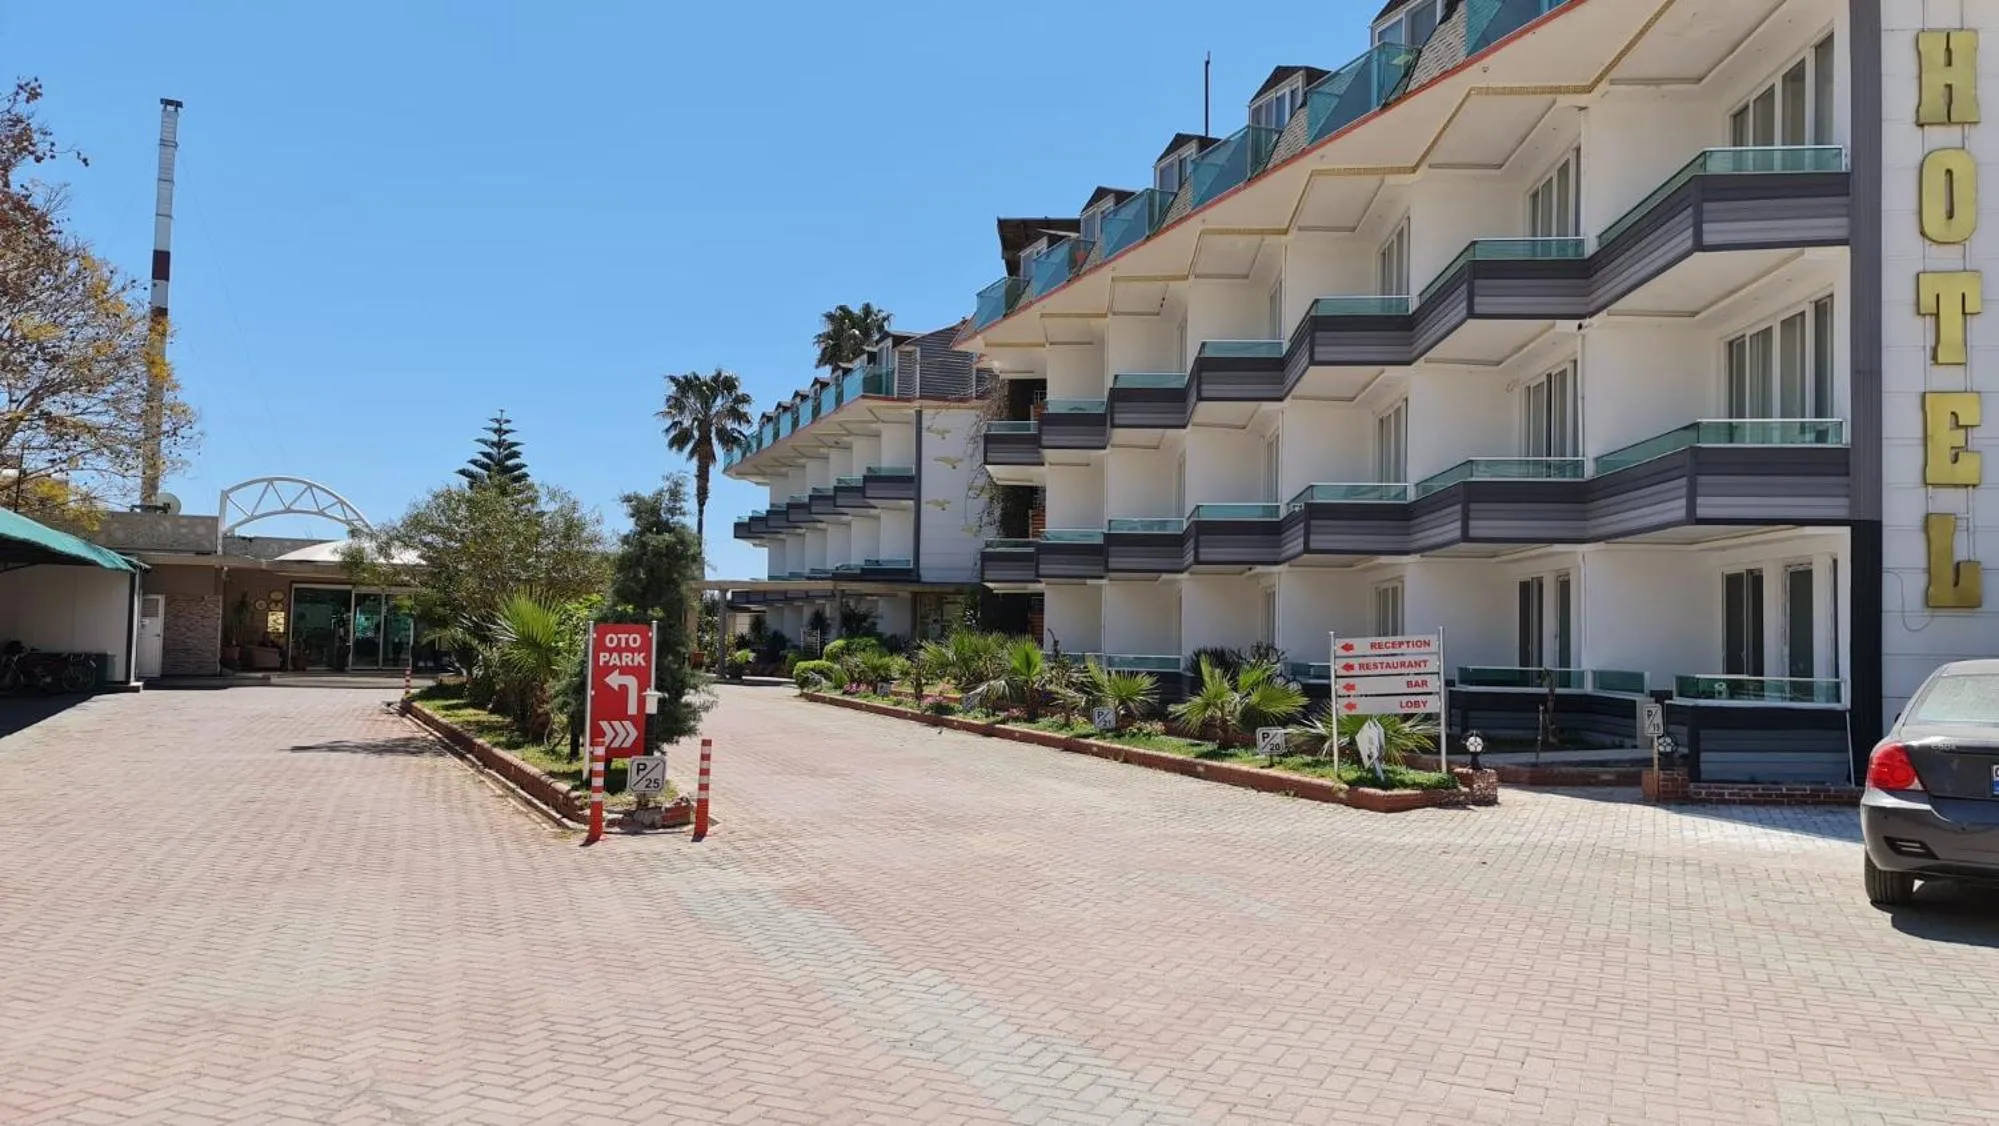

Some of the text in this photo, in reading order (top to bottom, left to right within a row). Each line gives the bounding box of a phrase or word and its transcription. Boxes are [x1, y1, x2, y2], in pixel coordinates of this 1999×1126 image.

[1916, 29, 1982, 608] HOTEL
[605, 633, 641, 648] OTO
[1370, 639, 1431, 651] RECEPTION
[599, 652, 646, 666] PARK
[1358, 659, 1429, 671] RESTAURANT
[1406, 679, 1429, 689] BAR
[1400, 700, 1428, 709] LOBY
[1097, 711, 1104, 720] P
[1261, 732, 1270, 742] P
[1269, 742, 1280, 751] 20
[636, 762, 647, 777] P
[645, 778, 660, 789] 25
